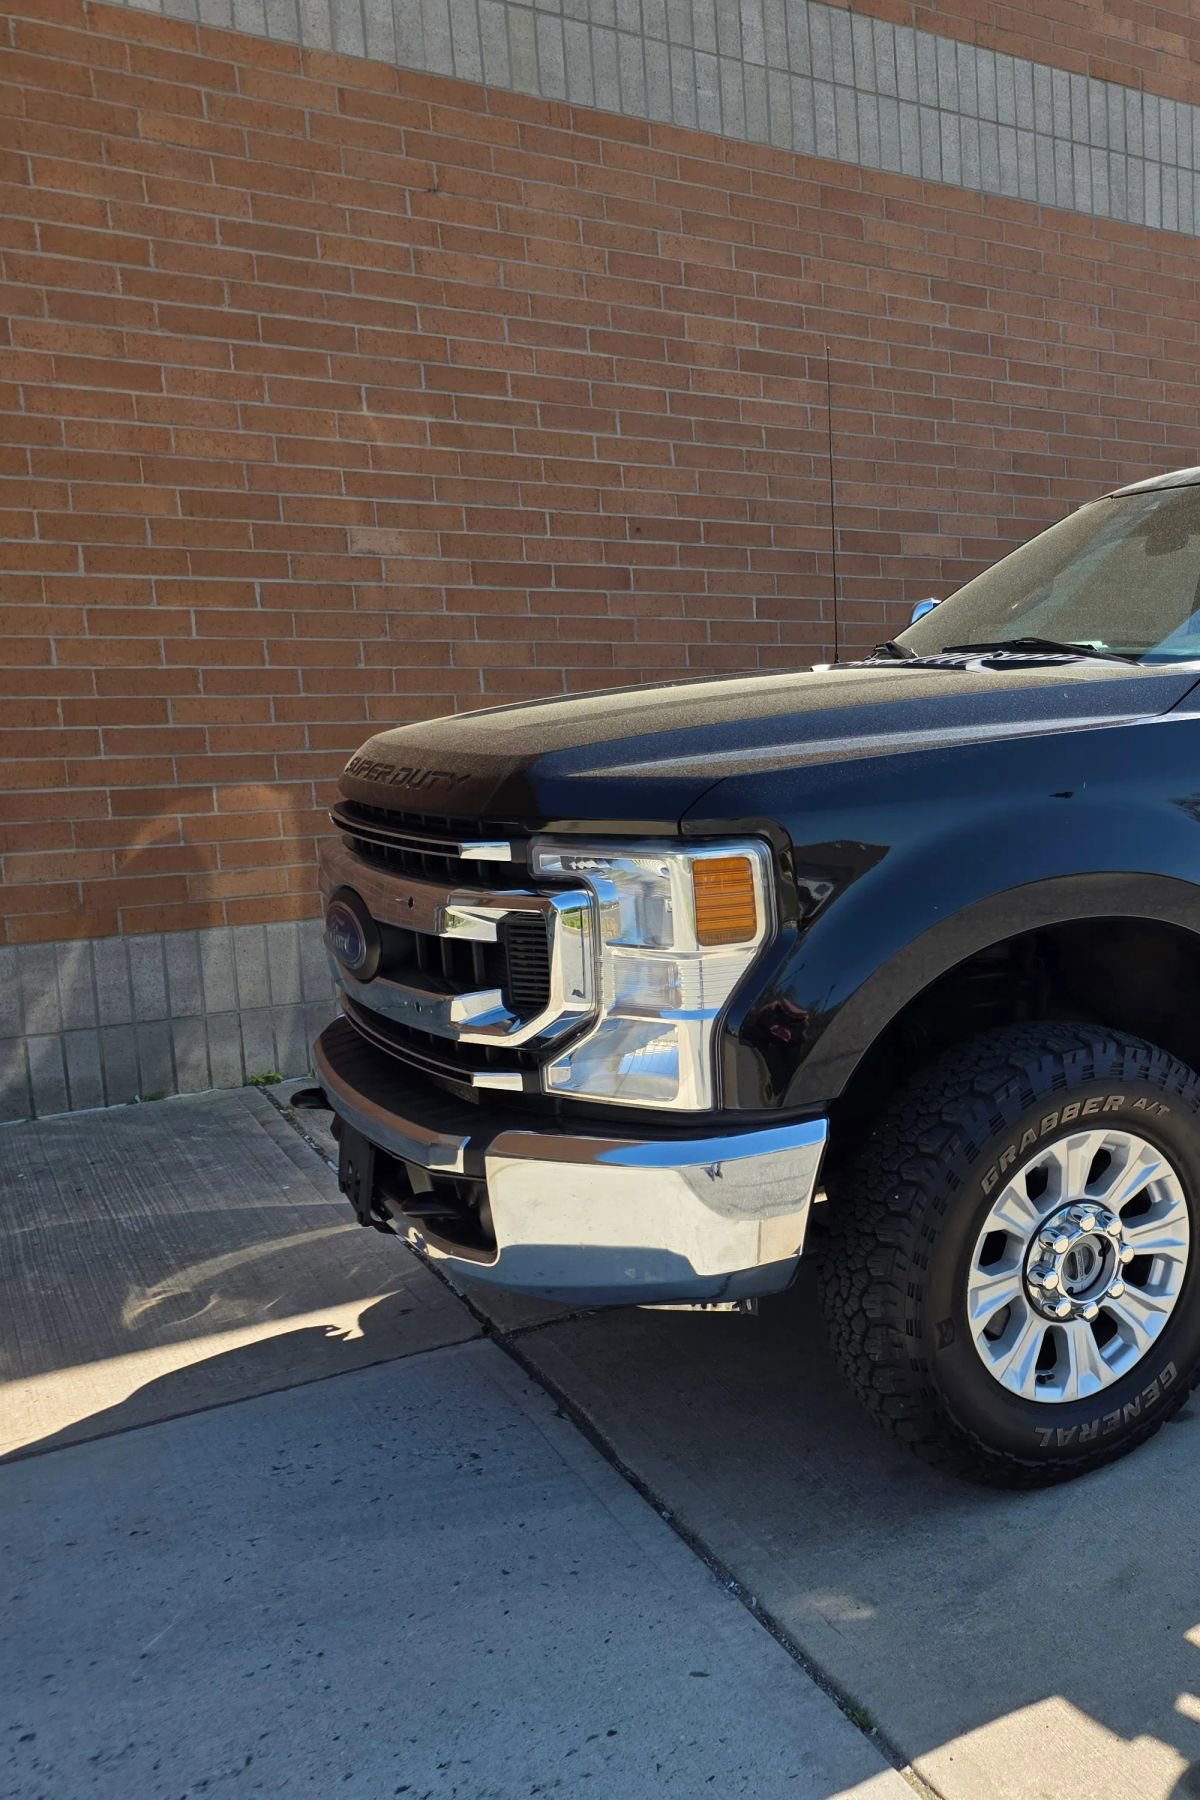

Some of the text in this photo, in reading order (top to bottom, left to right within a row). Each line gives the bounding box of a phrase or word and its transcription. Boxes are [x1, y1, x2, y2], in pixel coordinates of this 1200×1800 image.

[345, 756, 472, 792] SUPER DUTY
[980, 1095, 1171, 1195] GRABBER A/T
[1034, 1361, 1178, 1447] GENERAL
